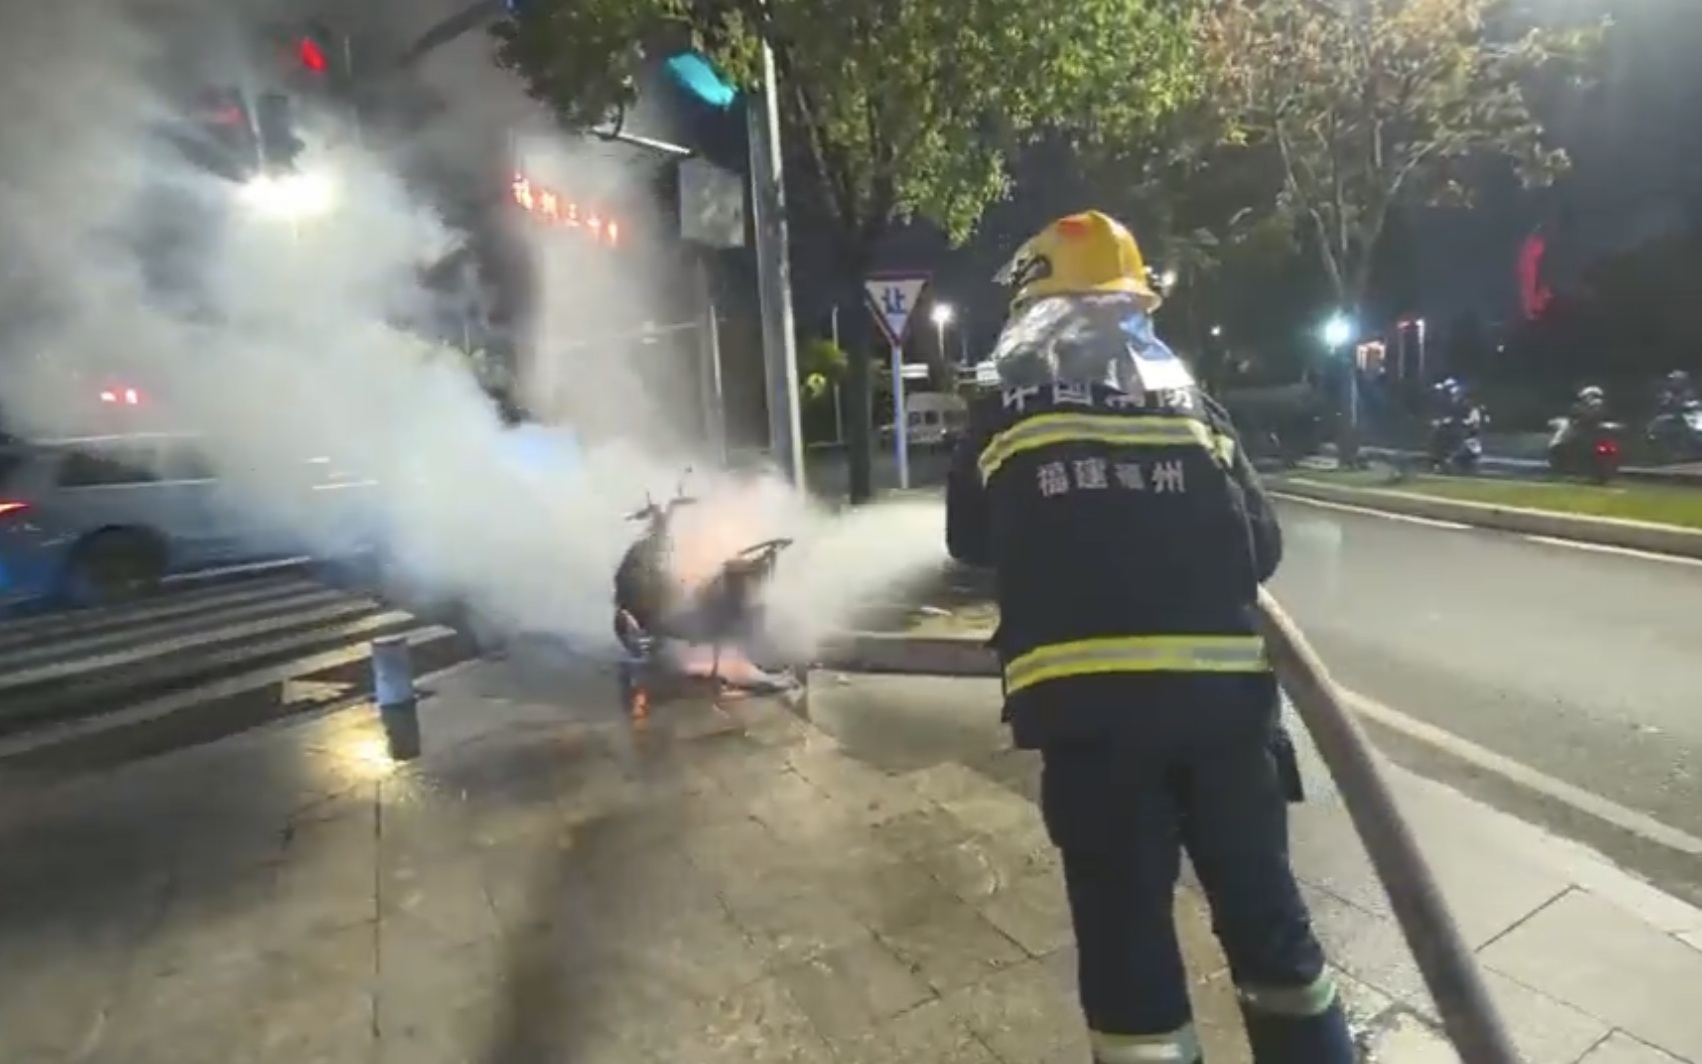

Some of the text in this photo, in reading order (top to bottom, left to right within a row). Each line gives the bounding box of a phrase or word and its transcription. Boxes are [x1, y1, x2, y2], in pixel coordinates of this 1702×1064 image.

[880, 286, 906, 314] 让
[1036, 457, 1186, 497] 福建福州
